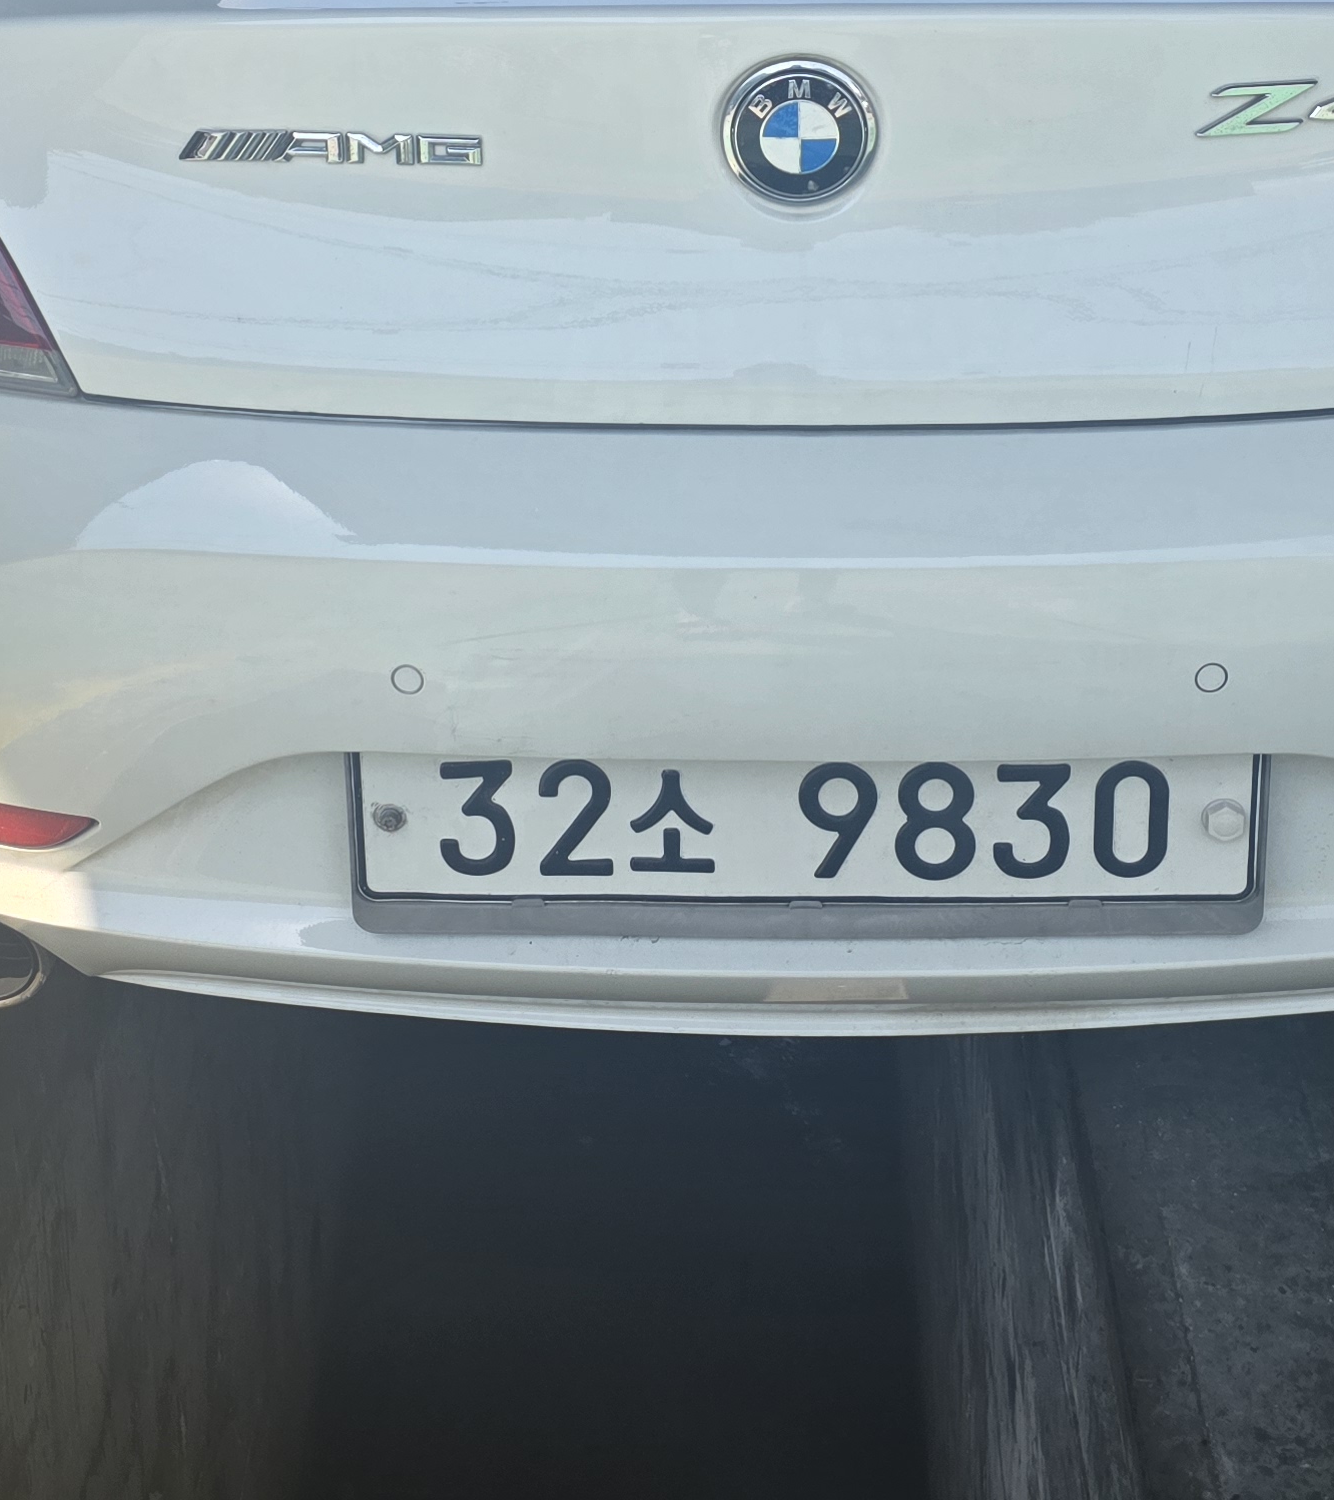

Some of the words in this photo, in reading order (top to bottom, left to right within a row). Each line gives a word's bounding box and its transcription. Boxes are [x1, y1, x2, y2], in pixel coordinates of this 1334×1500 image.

[747, 78, 853, 120] BMW
[439, 758, 717, 878] 32소
[797, 760, 1171, 882] 9830
